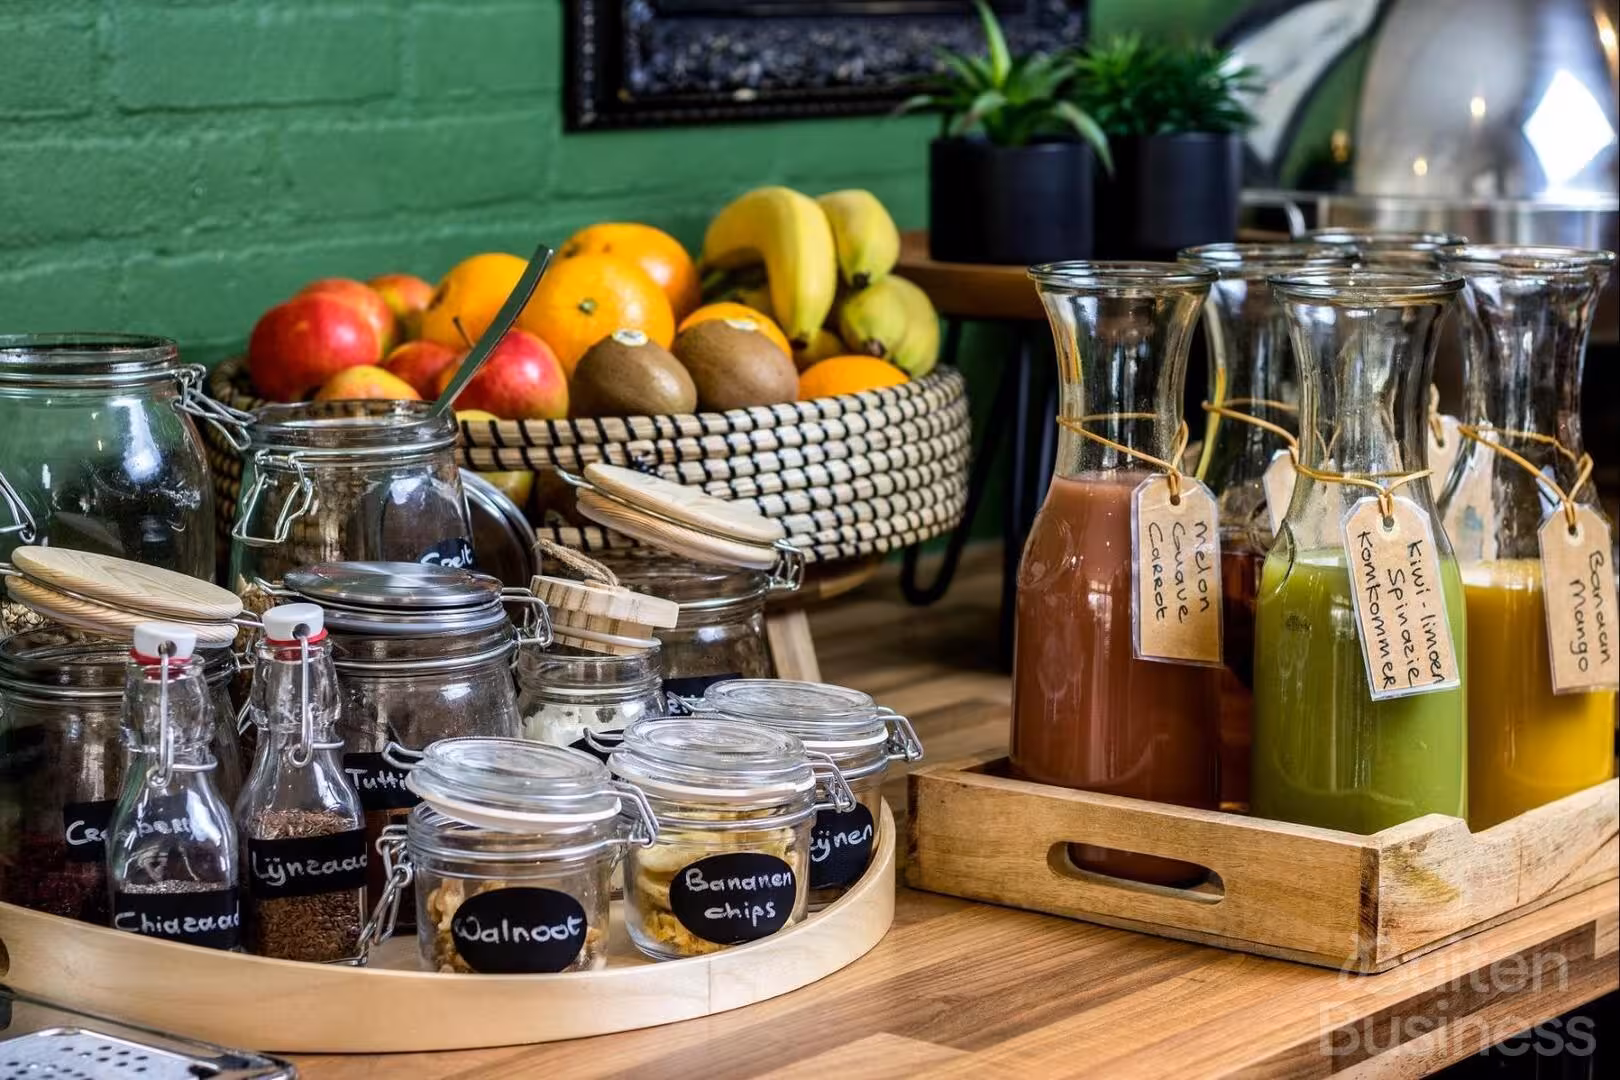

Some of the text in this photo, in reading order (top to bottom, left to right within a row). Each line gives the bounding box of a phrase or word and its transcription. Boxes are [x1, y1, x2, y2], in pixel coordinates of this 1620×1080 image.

[1172, 521, 1189, 624] Guave
[1386, 568, 1421, 689] Spinazie
[1568, 578, 1589, 673] Mango
[1588, 549, 1611, 665] Banaan
[343, 767, 407, 791] Tutti
[684, 867, 792, 892] Bananen
[454, 914, 584, 945] Walnoot
[703, 900, 777, 928] chips
